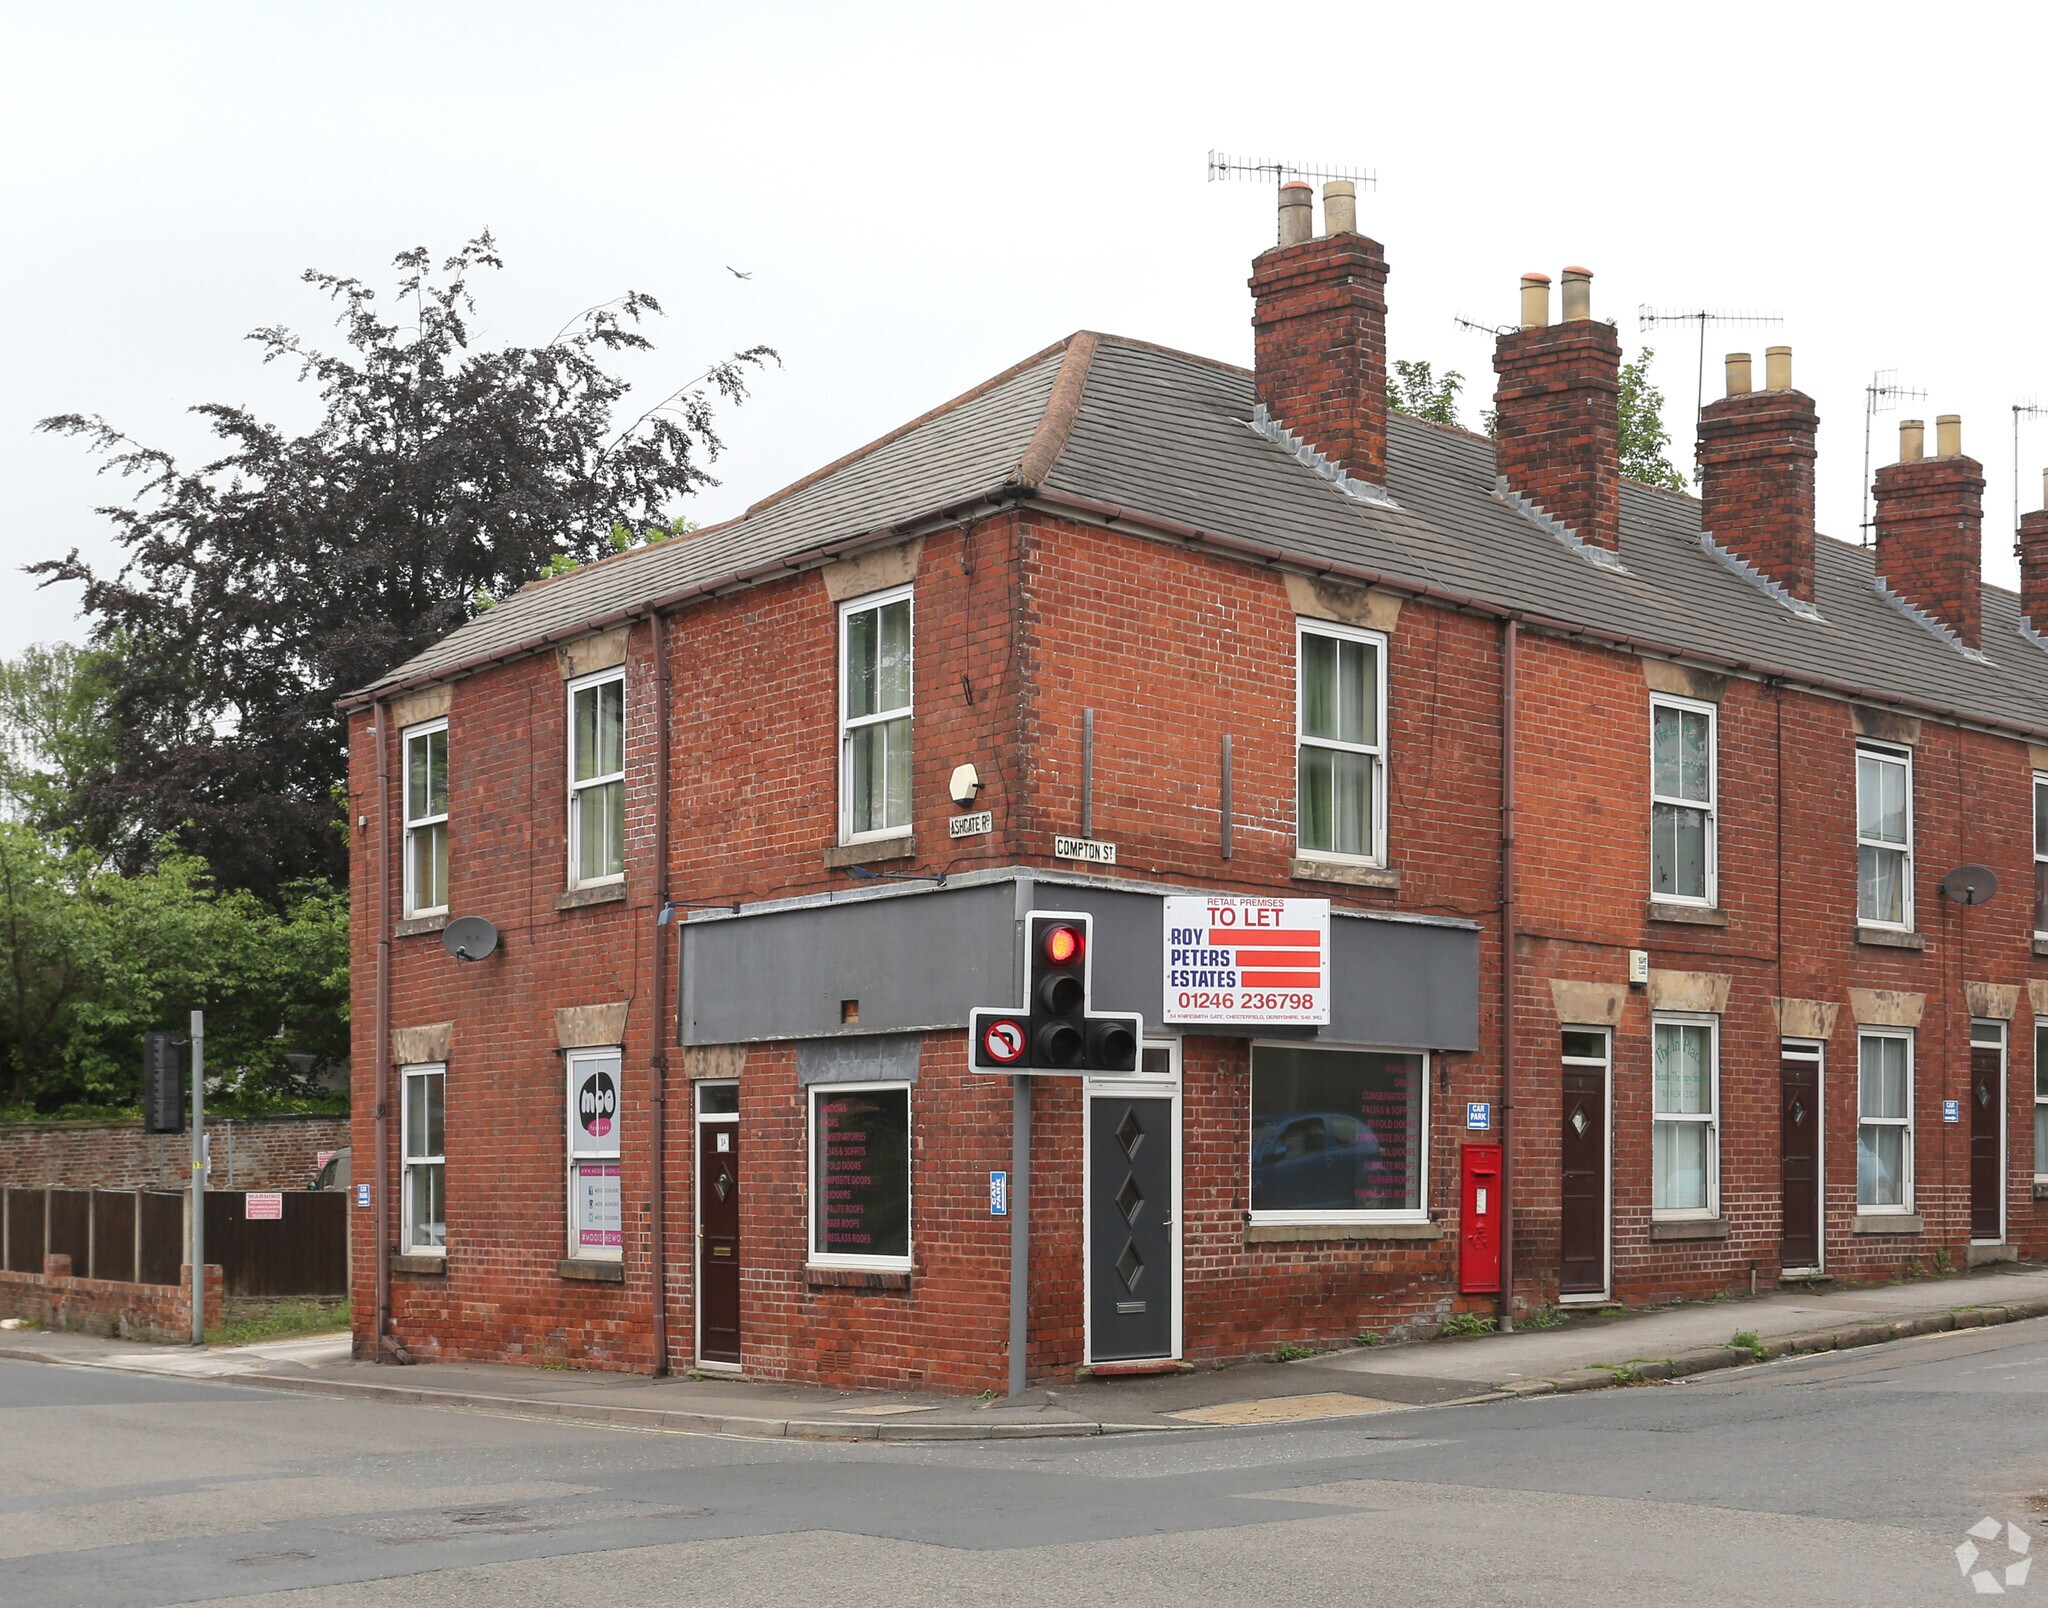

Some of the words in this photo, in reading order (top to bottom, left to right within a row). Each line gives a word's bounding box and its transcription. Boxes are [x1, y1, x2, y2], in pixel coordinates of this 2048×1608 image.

[951, 817, 979, 834] ASHGATE
[1057, 839, 1099, 859] COMPTON
[1207, 898, 1237, 906] RETAIL
[1240, 899, 1284, 907] PREMISES
[1207, 907, 1236, 926] TO
[1244, 908, 1284, 927] LET
[1171, 928, 1203, 945] ROY
[1171, 949, 1230, 967] PETERS
[1171, 970, 1237, 988] ESTATES
[1178, 992, 1234, 1009] 01246
[1241, 993, 1314, 1010] 236798
[1656, 1043, 1669, 1063] The
[1671, 1035, 1681, 1052] In
[1671, 1072, 1693, 1084] Theapy
[582, 1089, 614, 1113] moo
